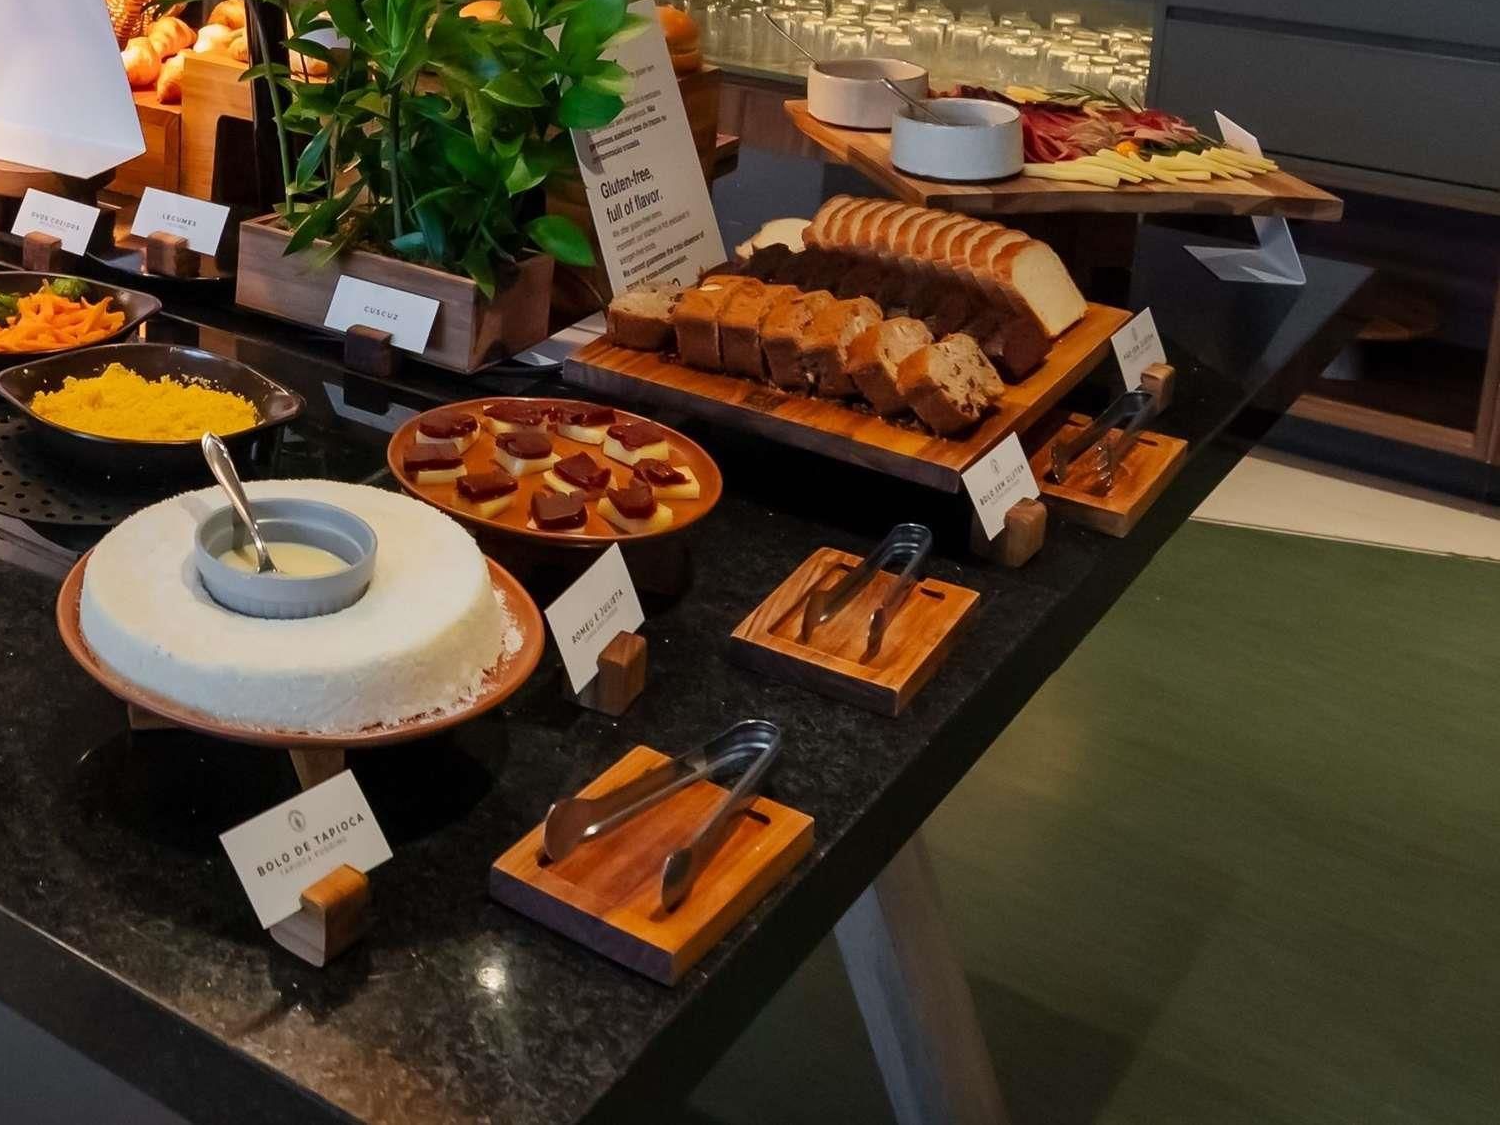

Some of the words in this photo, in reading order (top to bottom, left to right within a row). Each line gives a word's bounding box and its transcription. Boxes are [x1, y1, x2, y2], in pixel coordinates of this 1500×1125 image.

[600, 167, 654, 199] Gluten-free,
[606, 202, 623, 224] full
[624, 197, 634, 216] of
[635, 188, 663, 212] flavor.
[364, 306, 398, 320] CUSCUZ
[257, 851, 290, 876] BOLO
[294, 842, 311, 857] DE
[315, 814, 364, 846] TAPIOCA
